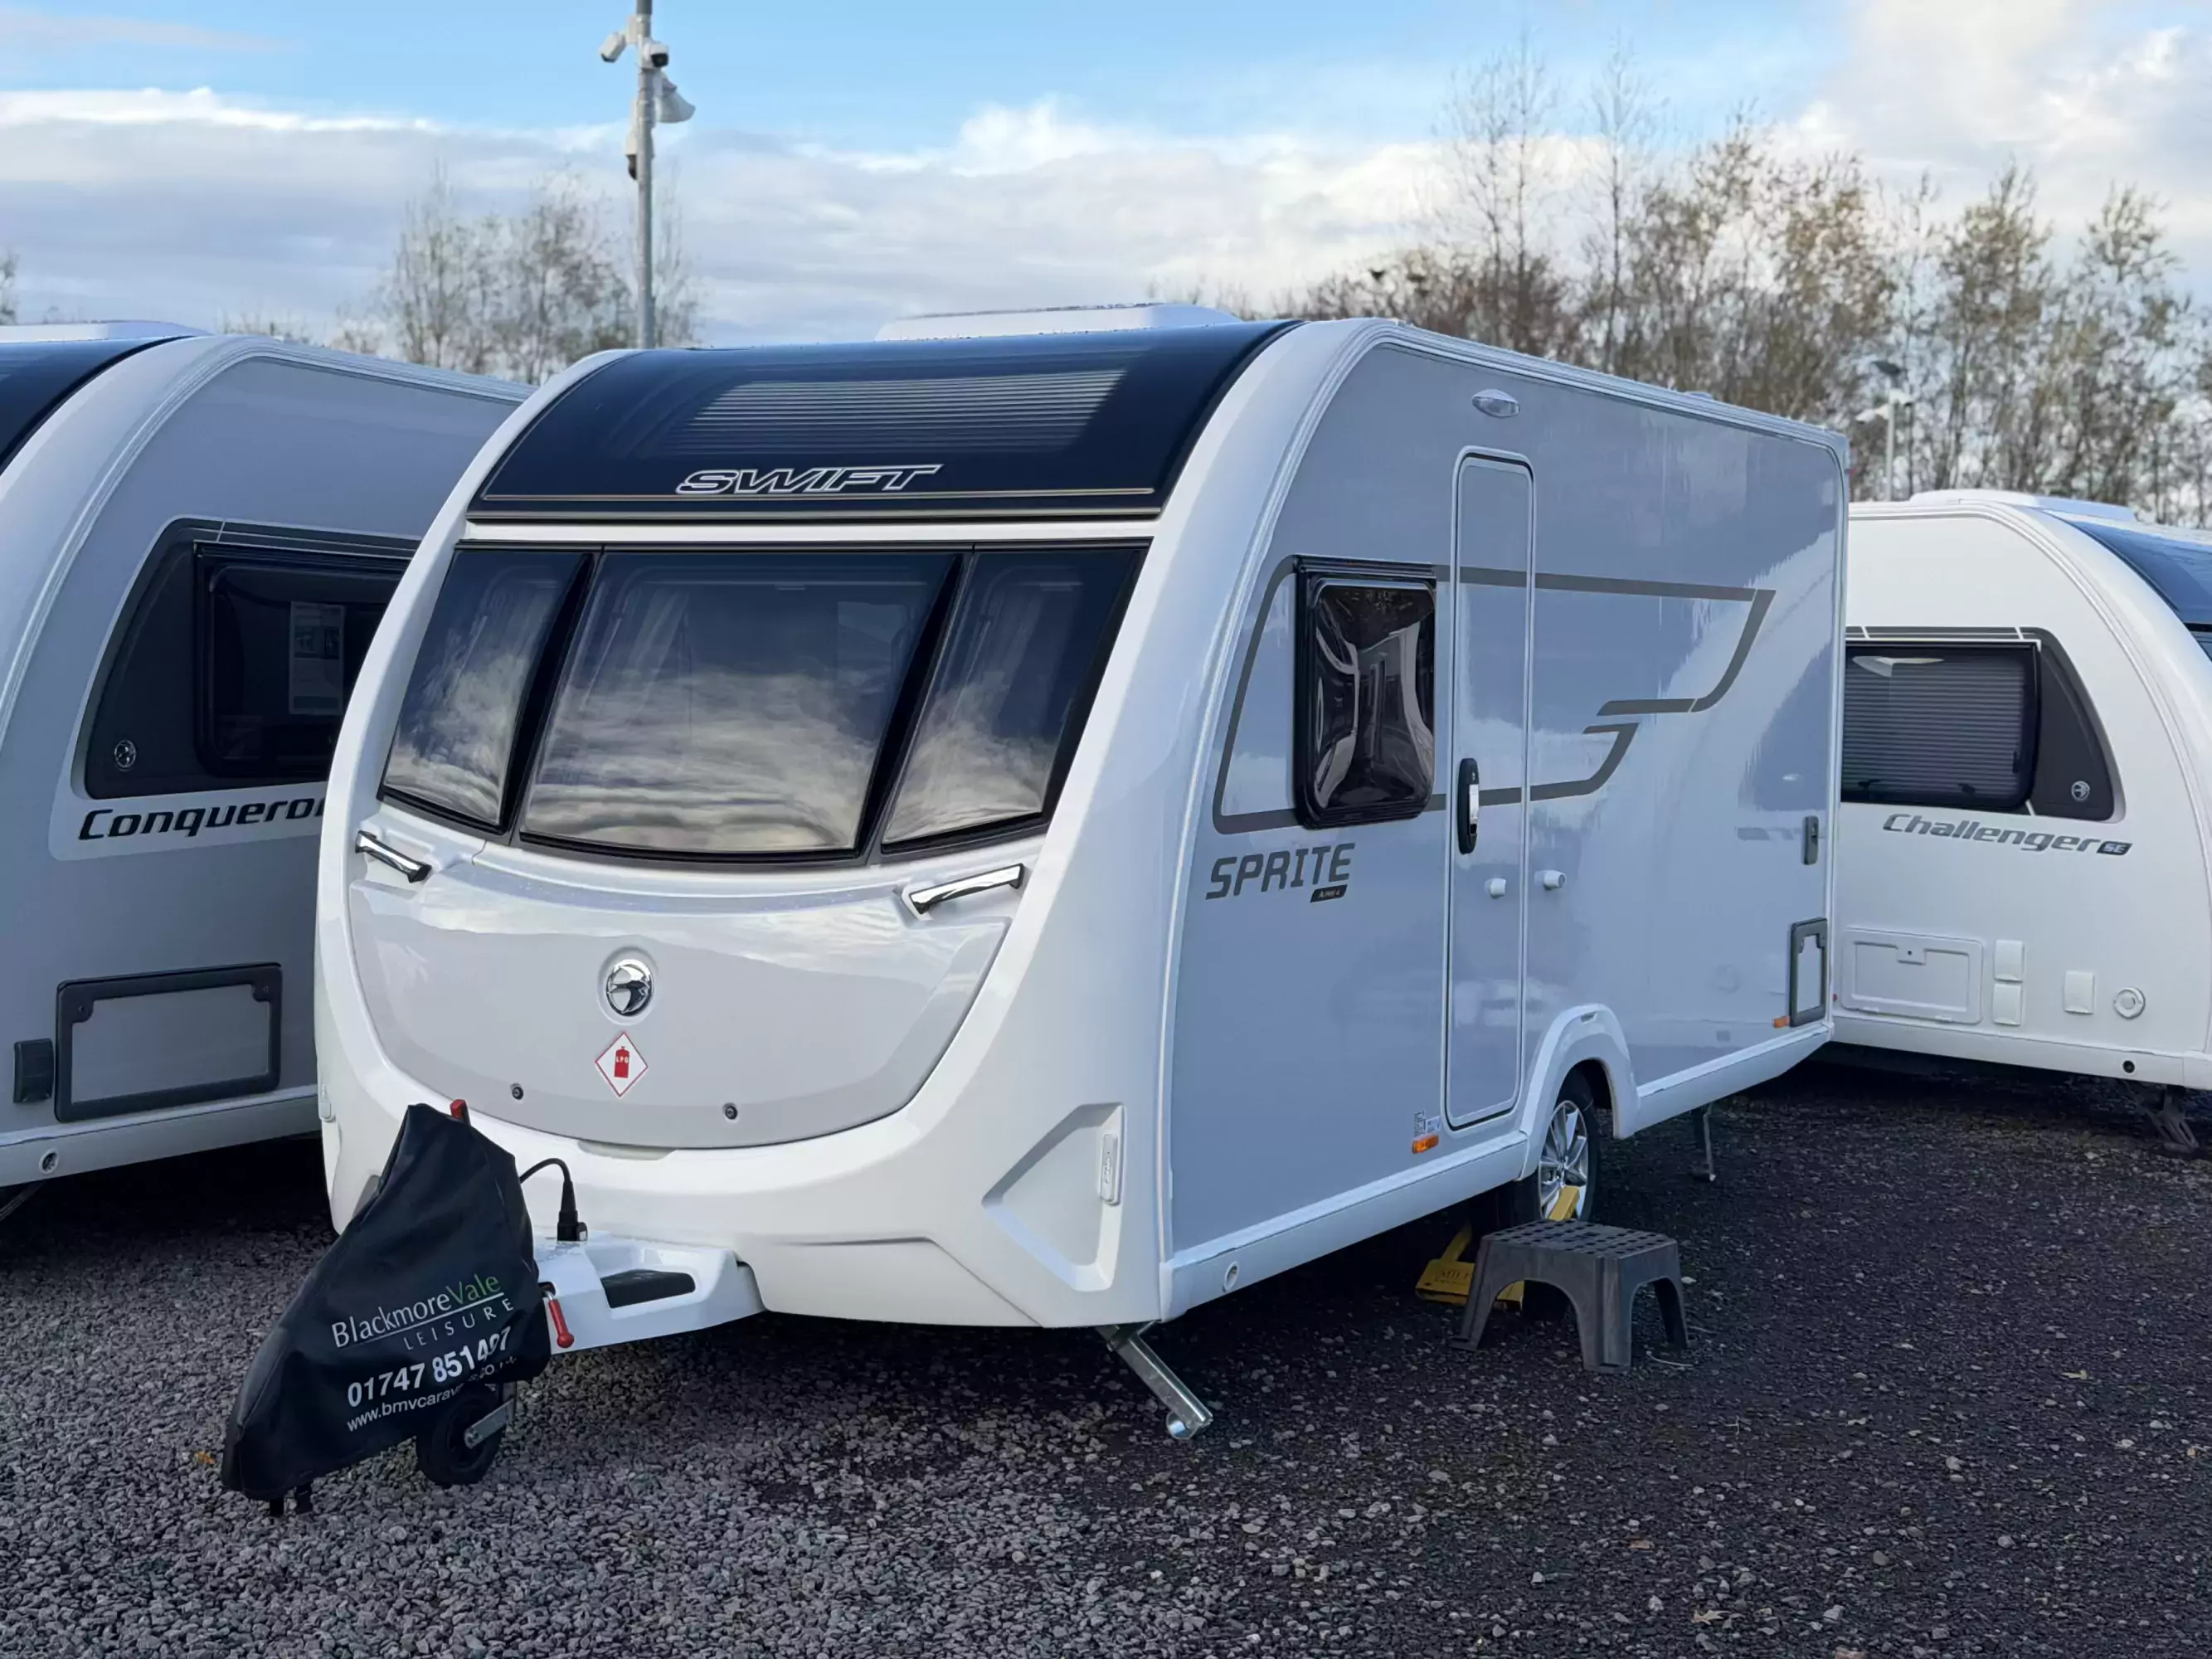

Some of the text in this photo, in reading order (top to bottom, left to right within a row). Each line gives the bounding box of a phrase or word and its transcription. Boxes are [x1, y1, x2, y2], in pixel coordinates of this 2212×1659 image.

[675, 464, 945, 494] SWIFT
[1882, 813, 2126, 854] Challenger SE
[1205, 842, 1356, 901] SPRITE
[615, 1055, 630, 1064] LPG
[403, 1297, 514, 1350] LEISURE
[347, 1362, 426, 1408] 01747
